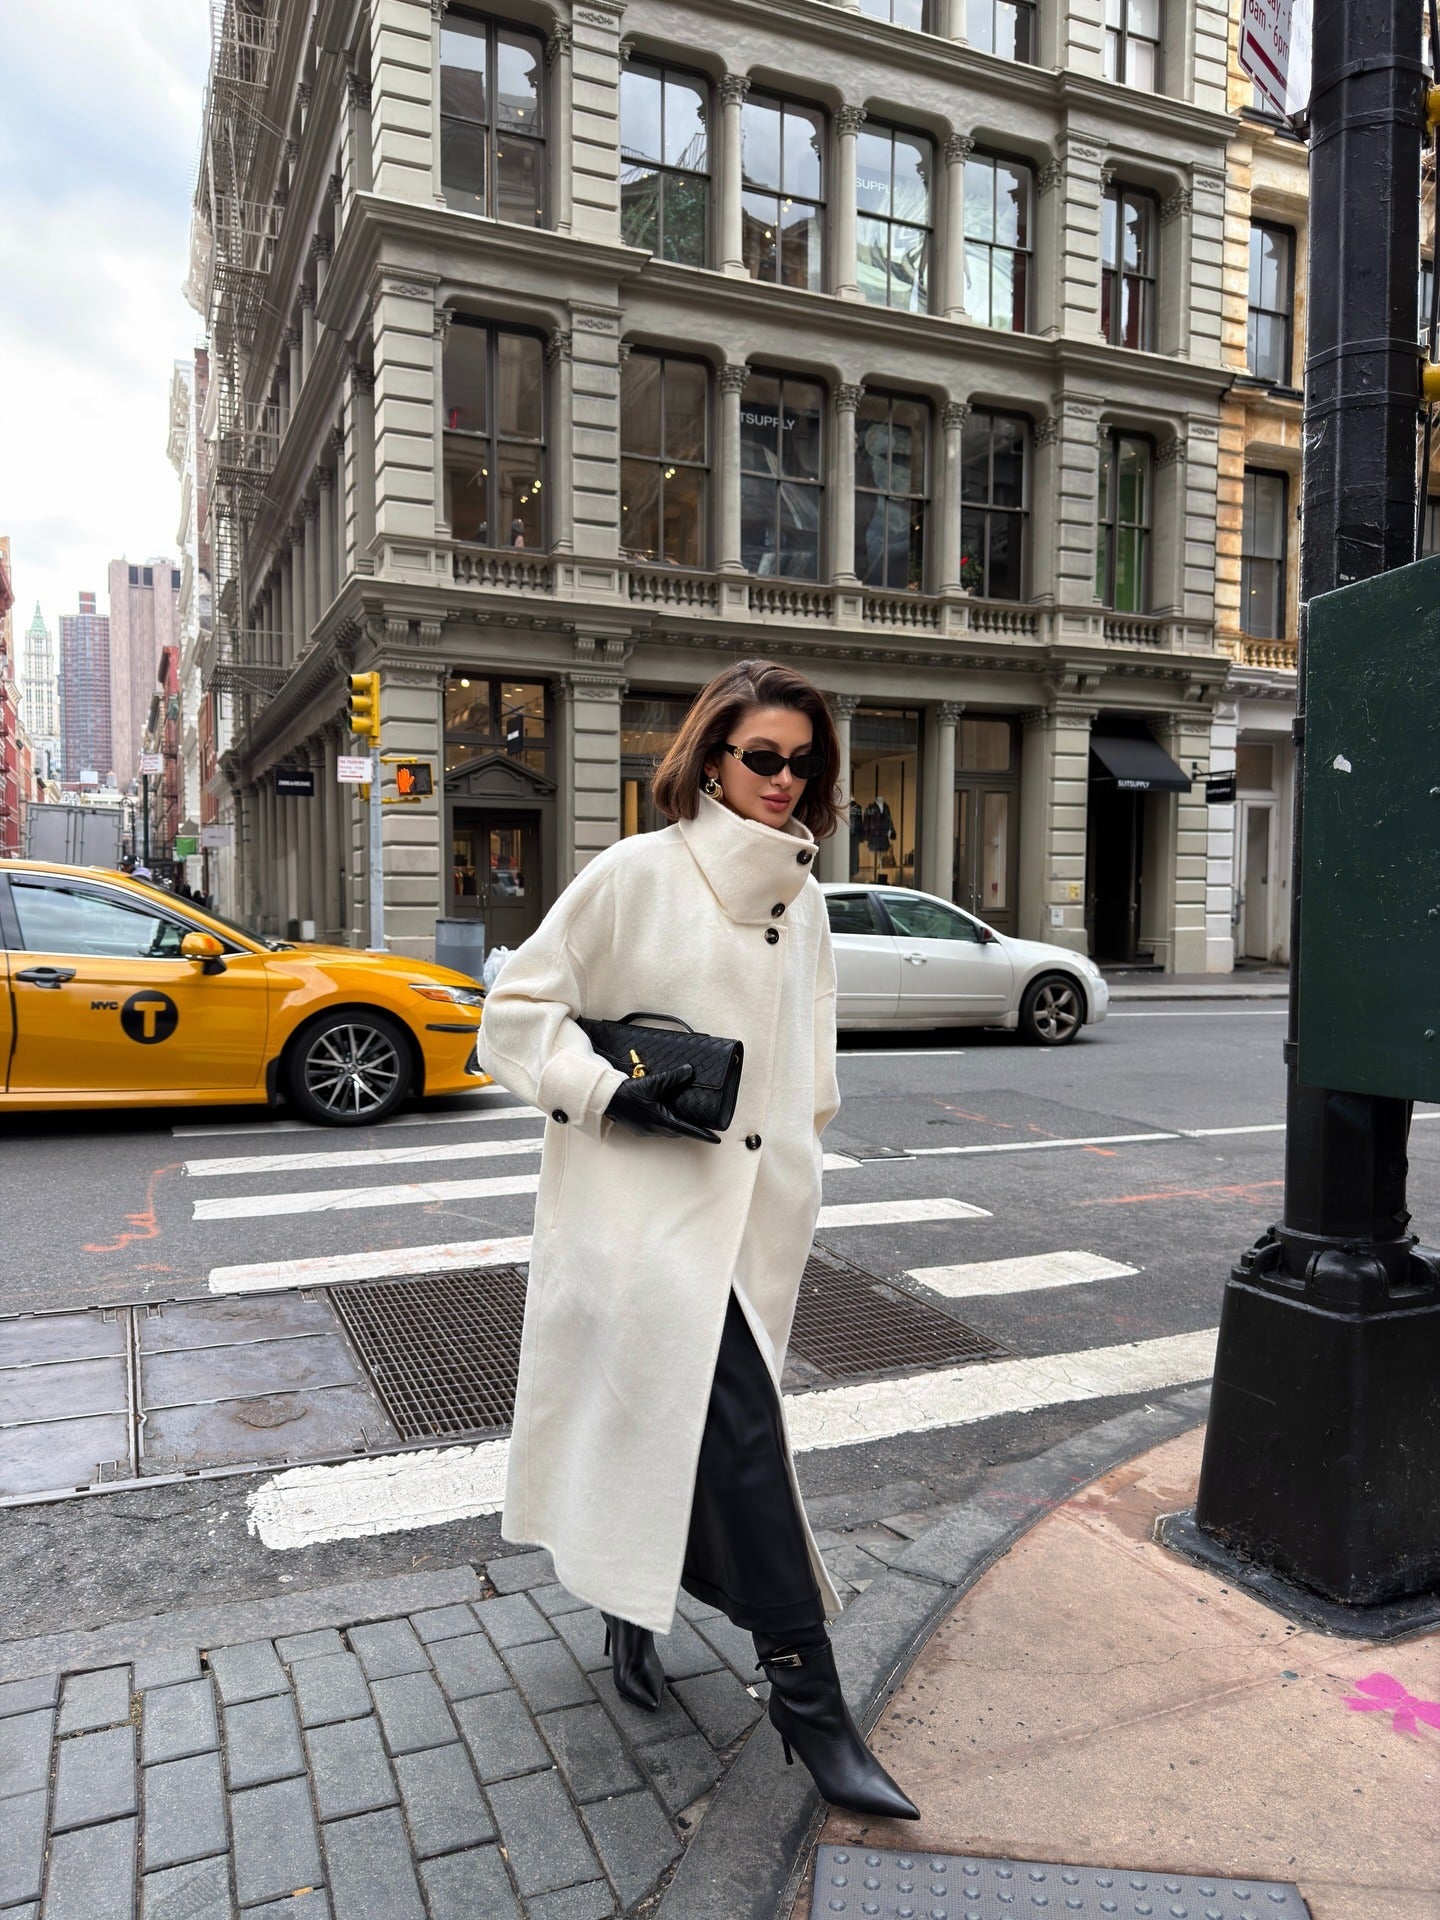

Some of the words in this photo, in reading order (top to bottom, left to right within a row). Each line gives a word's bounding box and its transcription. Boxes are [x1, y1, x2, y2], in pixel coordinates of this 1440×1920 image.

[1274, 25, 1290, 63] 6pm
[1118, 780, 1150, 788] SUITSUPPLY
[91, 1001, 119, 1010] NYC
[134, 1001, 166, 1038] T
